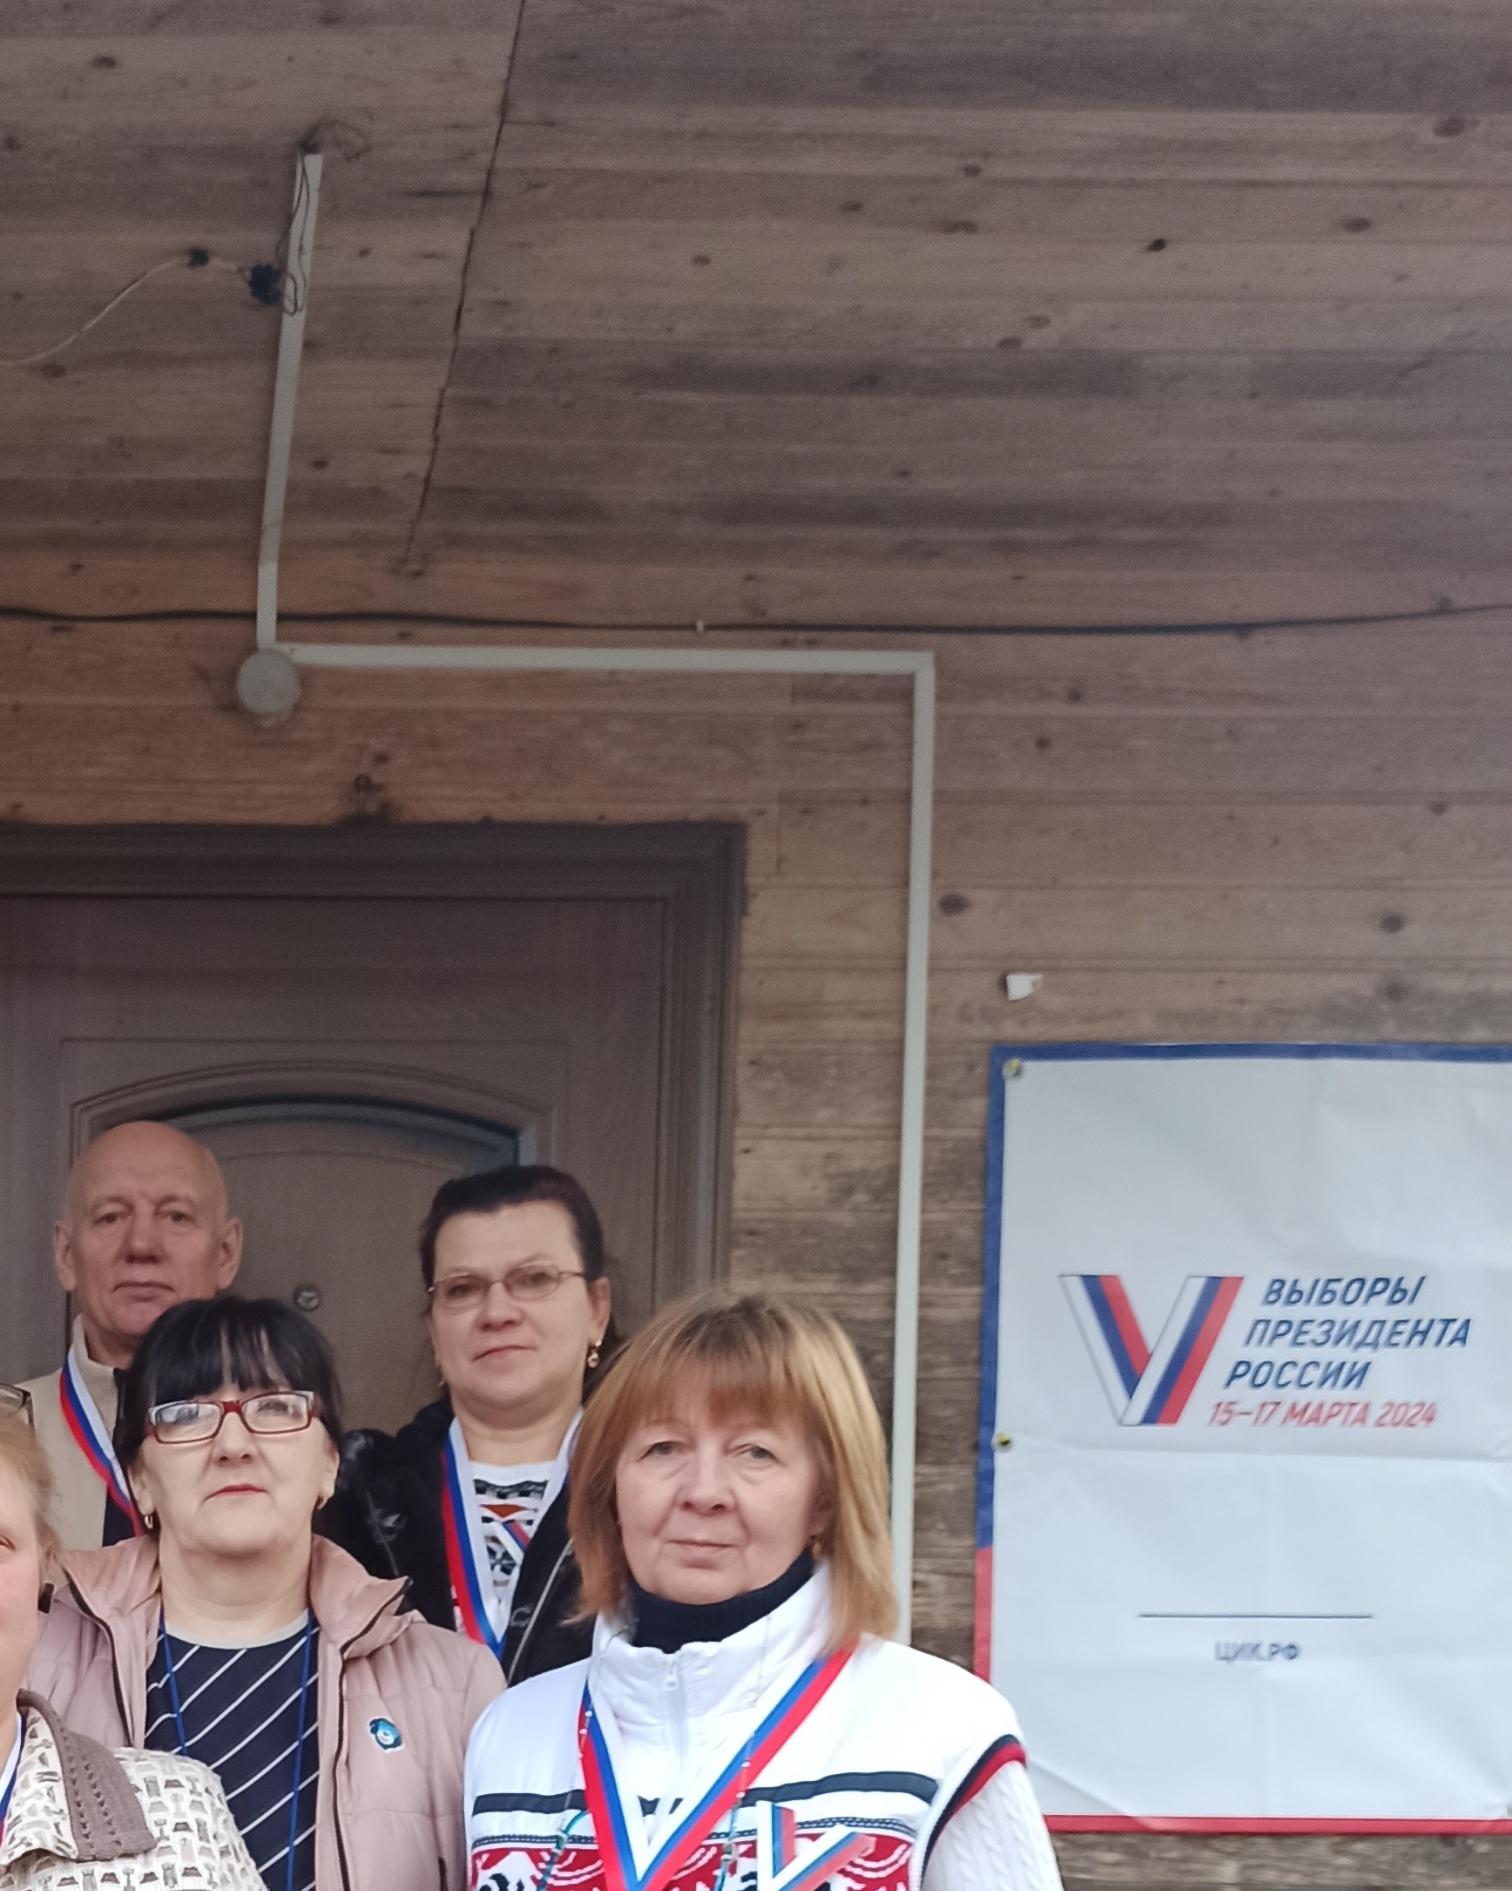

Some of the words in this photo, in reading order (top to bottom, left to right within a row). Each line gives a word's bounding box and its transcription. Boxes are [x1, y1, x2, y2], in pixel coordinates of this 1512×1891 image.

[1260, 1275, 1427, 1307] ВЫБОРЫ
[1243, 1317, 1472, 1352] ПРЕЗИДЕНТА
[1223, 1360, 1371, 1391] РОССИИ
[1278, 1400, 1368, 1428] МАРТА
[1370, 1402, 1438, 1428] 2024
